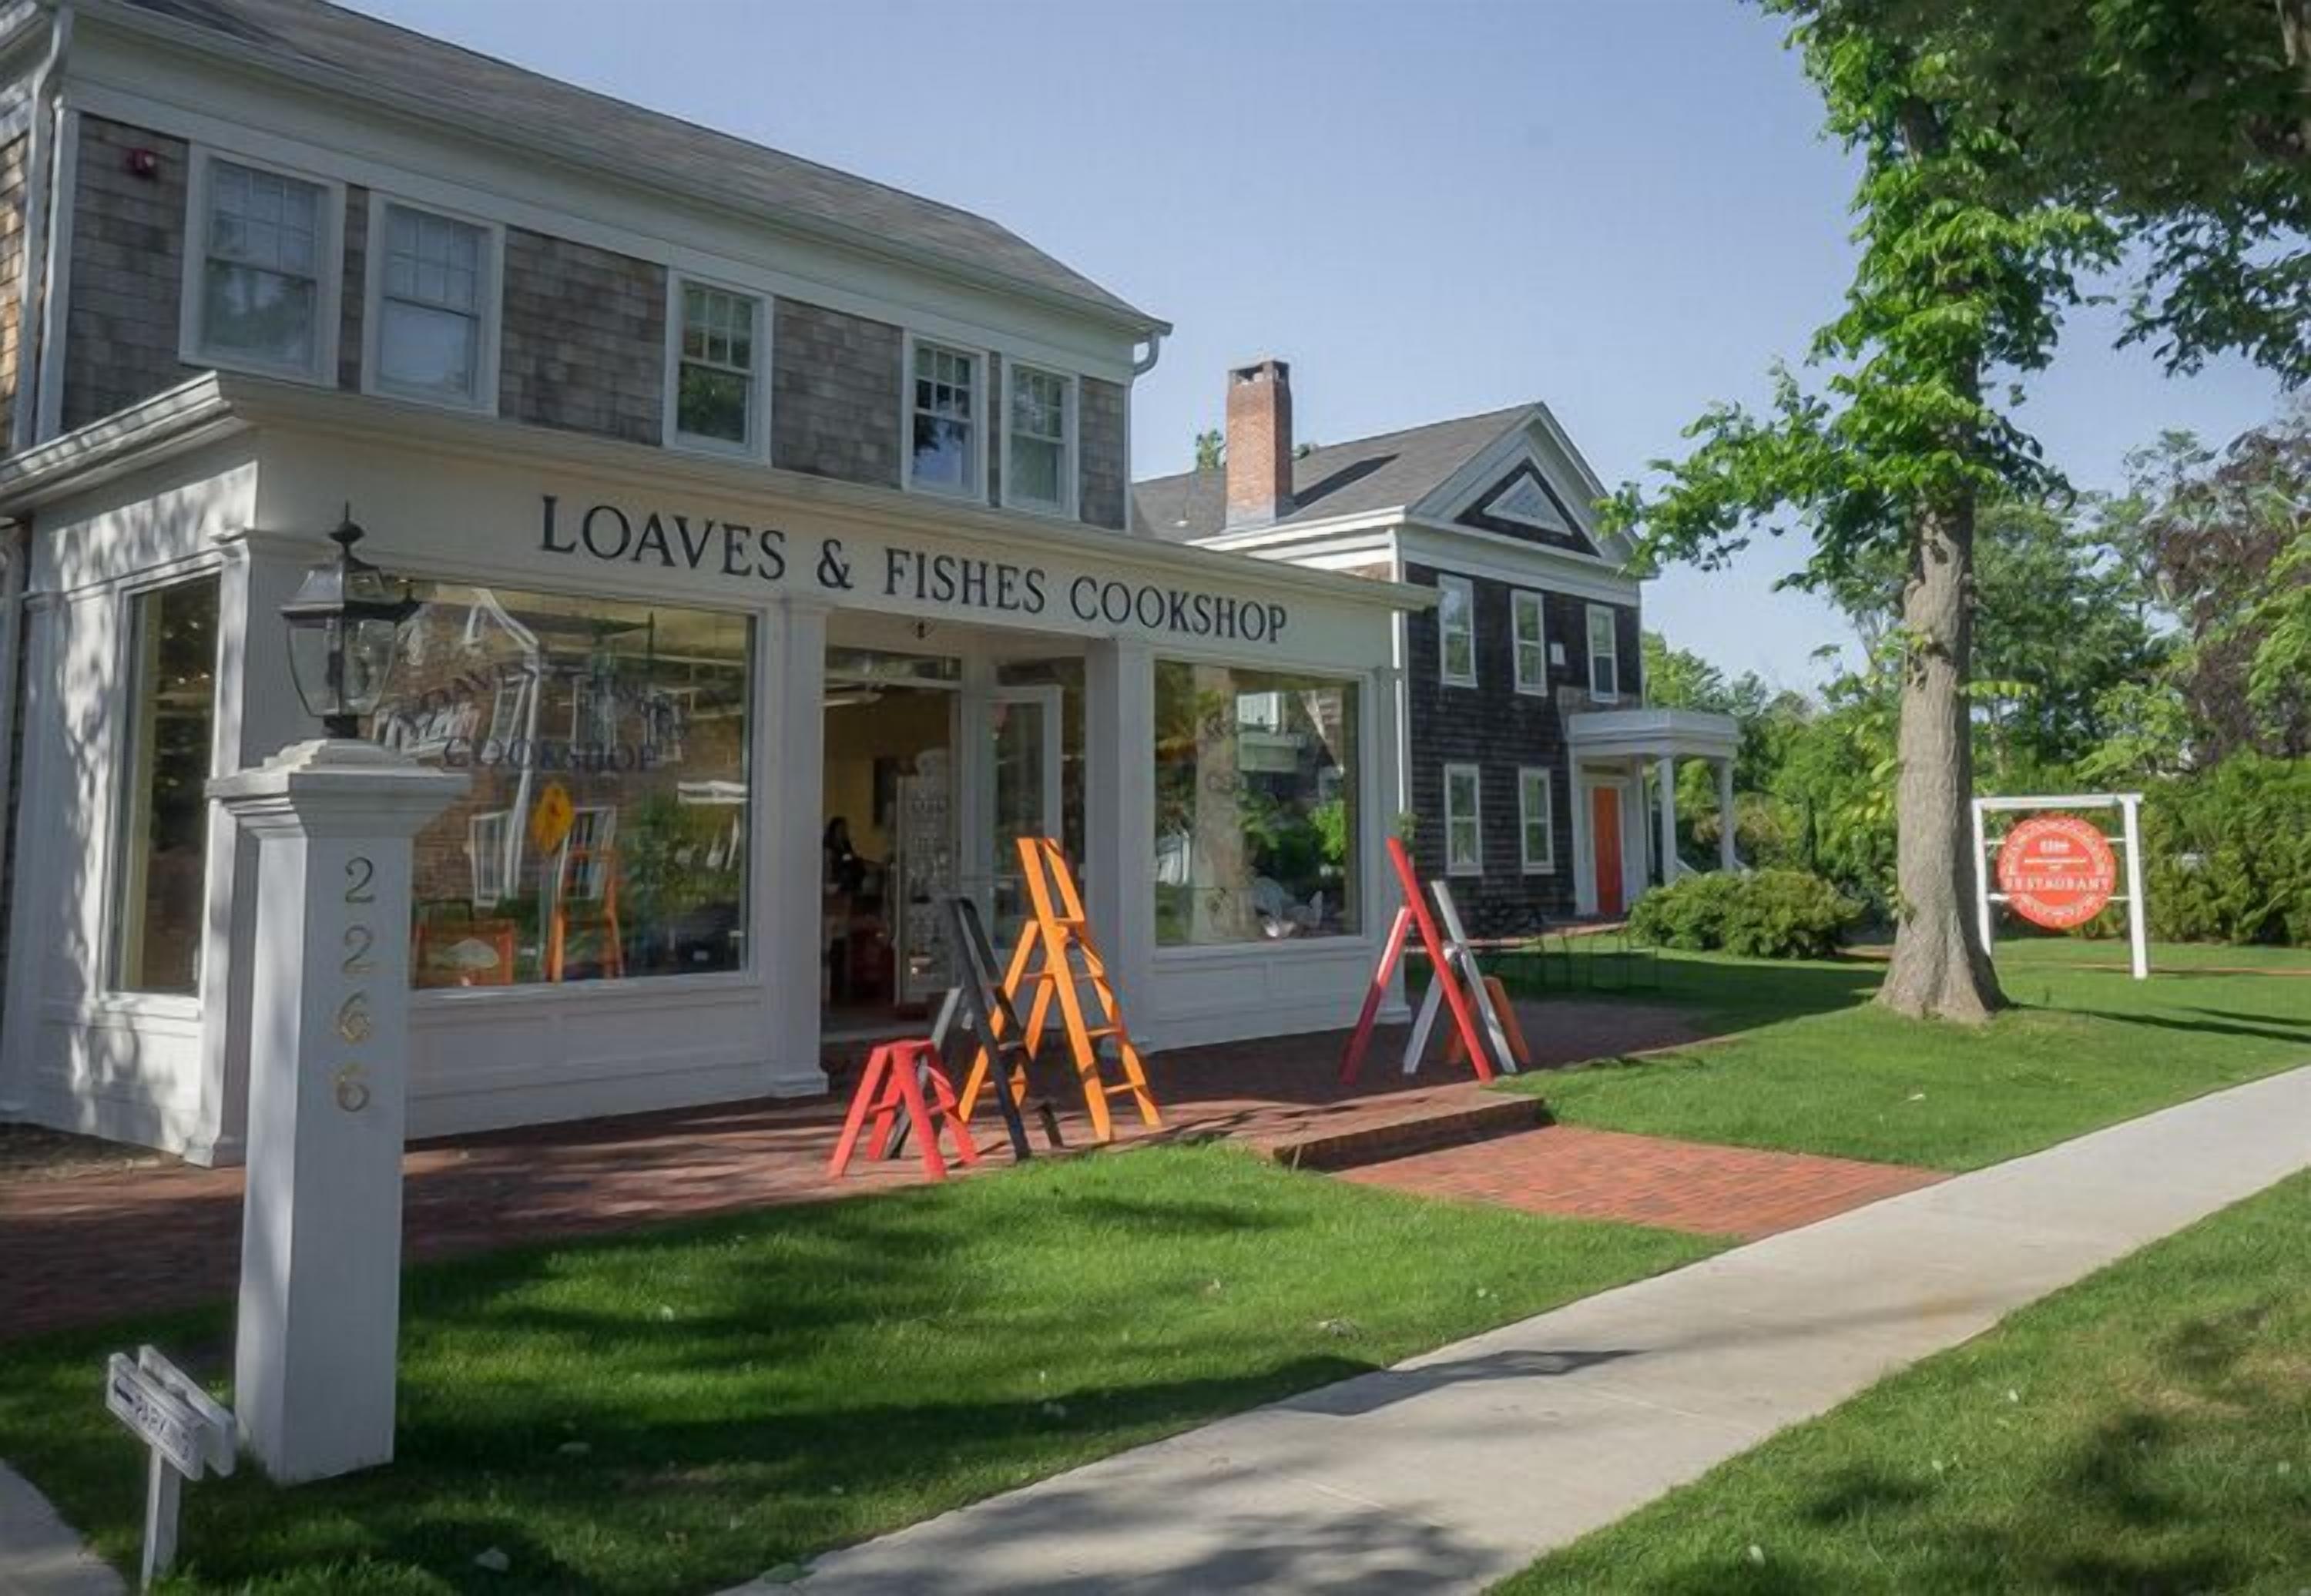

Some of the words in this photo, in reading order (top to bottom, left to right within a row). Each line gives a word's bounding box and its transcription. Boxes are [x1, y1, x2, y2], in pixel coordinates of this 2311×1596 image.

[541, 495, 787, 581] LOAVES
[816, 538, 854, 590] &
[884, 547, 1046, 615] FISHES
[1069, 575, 1288, 644] COOKSHOP
[336, 856, 376, 1112] 2266
